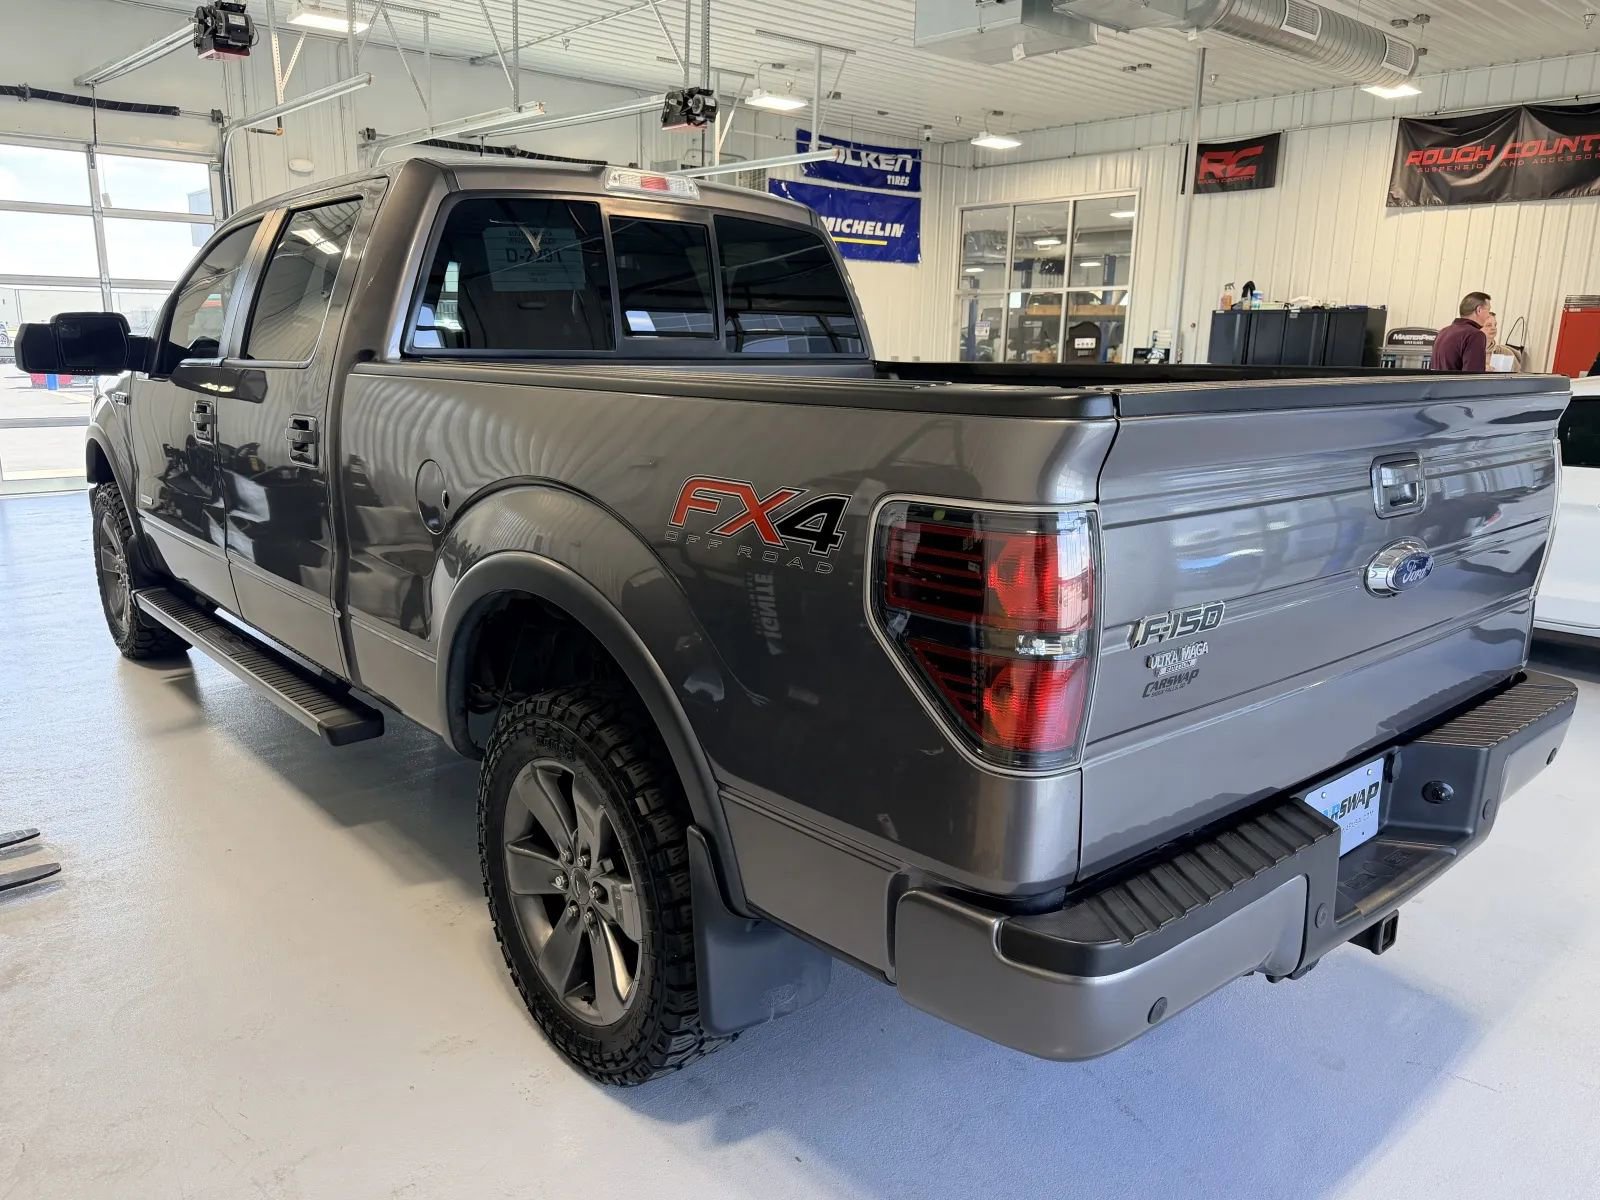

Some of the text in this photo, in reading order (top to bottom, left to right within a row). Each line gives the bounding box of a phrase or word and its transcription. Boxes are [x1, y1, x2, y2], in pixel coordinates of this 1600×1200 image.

[817, 143, 913, 173] ALKEN
[1199, 145, 1265, 180] RC
[1404, 133, 1600, 166] ROUGH COUNT
[886, 174, 909, 185] TIRES
[820, 216, 905, 238] MICHELIN
[667, 474, 853, 559] FX4
[664, 530, 834, 575] OFF ROAD
[1132, 602, 1226, 649] F-150
[1150, 642, 1209, 669] ULTRA MAGA
[1142, 668, 1200, 698] CARSWAP
[1322, 781, 1380, 821] ARSWAP
